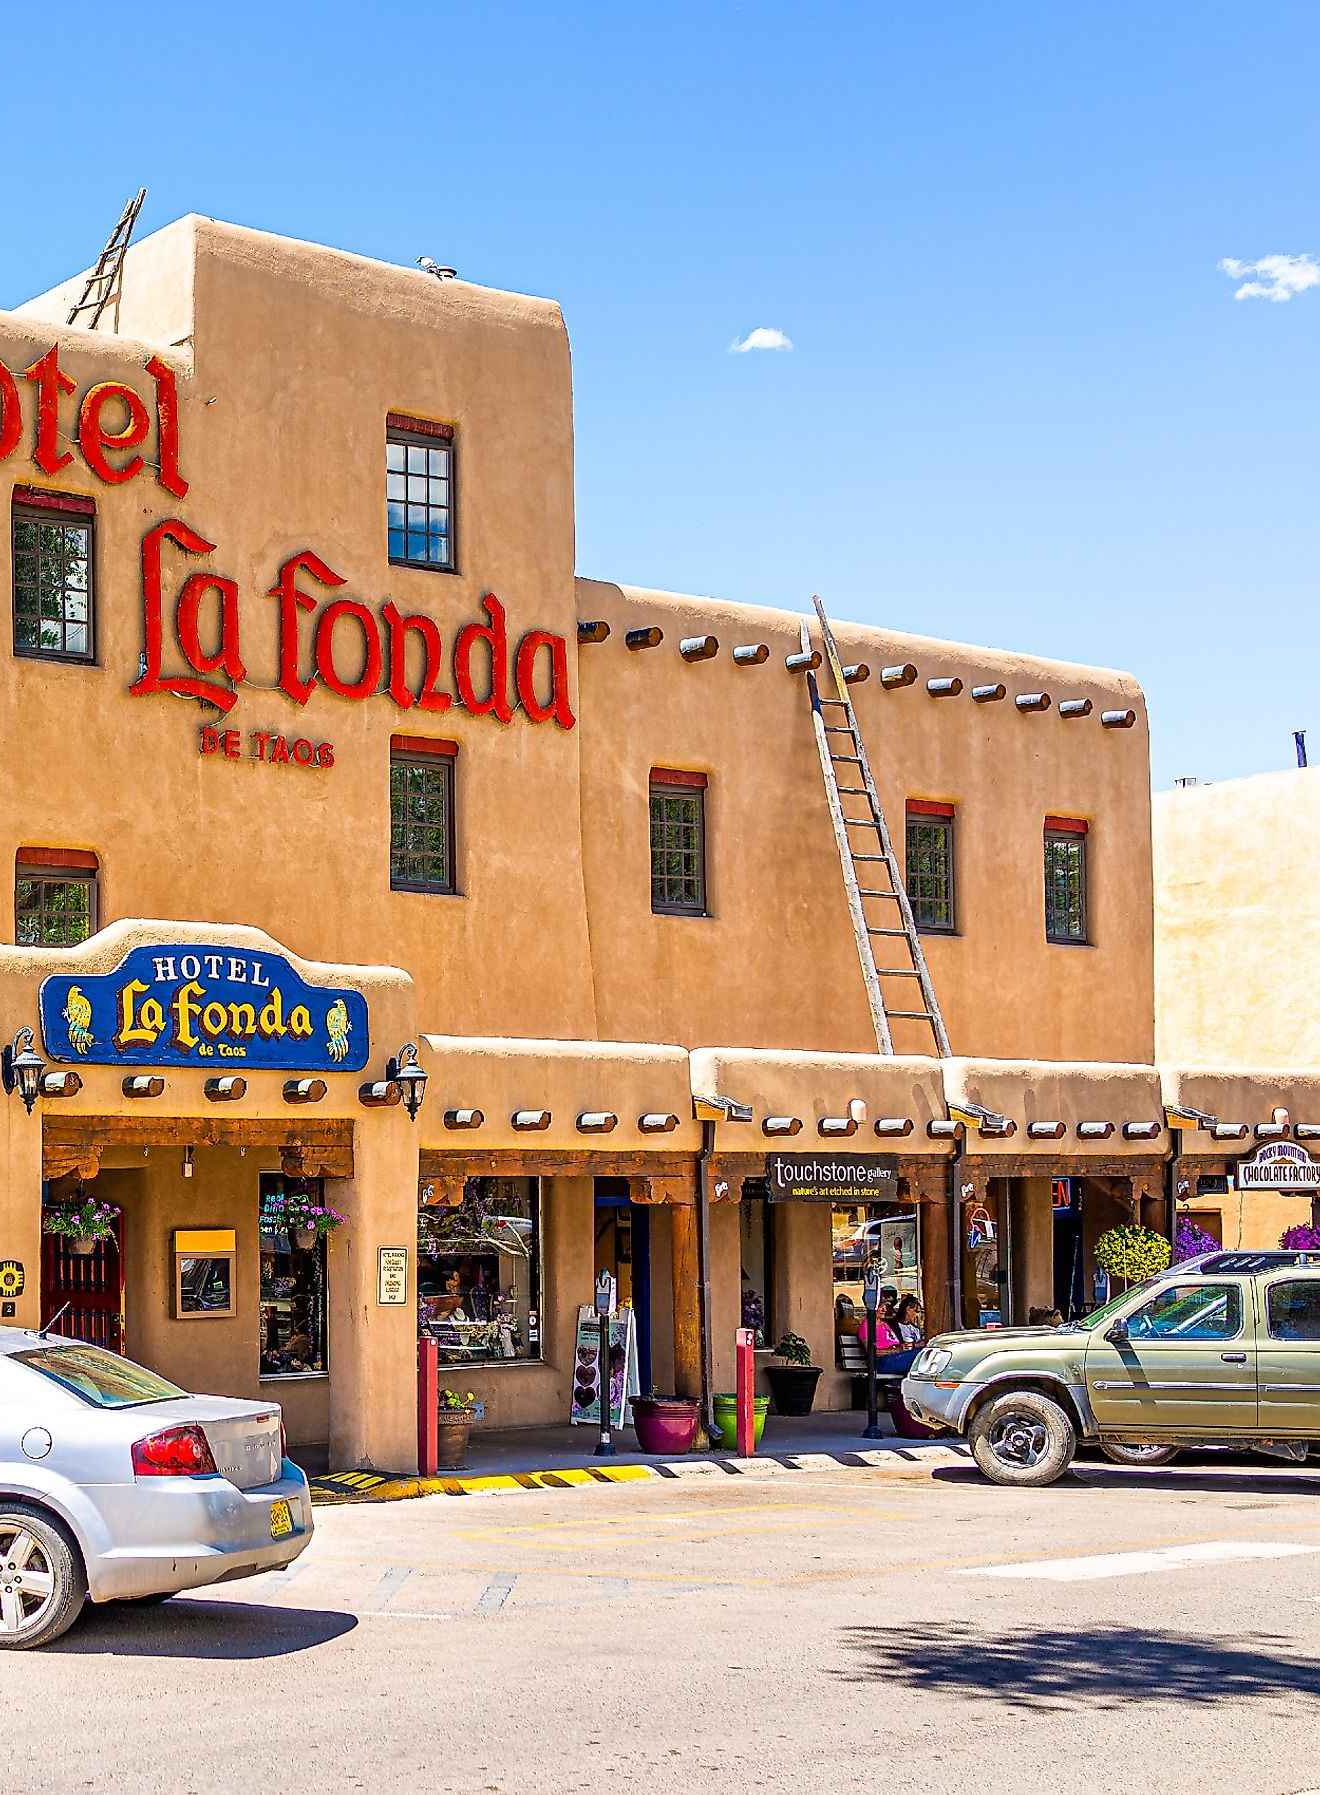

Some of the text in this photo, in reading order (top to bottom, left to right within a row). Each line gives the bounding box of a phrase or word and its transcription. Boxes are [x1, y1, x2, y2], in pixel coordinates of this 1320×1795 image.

[129, 519, 247, 713] La
[202, 727, 336, 769] DE TAOS
[152, 955, 270, 987] HOTEL
[114, 979, 167, 1051] La
[198, 1043, 214, 1057] de
[774, 1157, 892, 1188] touchstone gallery
[1243, 1166, 1288, 1186] CHOCOLATE
[792, 1186, 819, 1197] nature's
[819, 1187, 829, 1196] art
[860, 1187, 881, 1197] stone
[6, 1304, 12, 1313] 2
